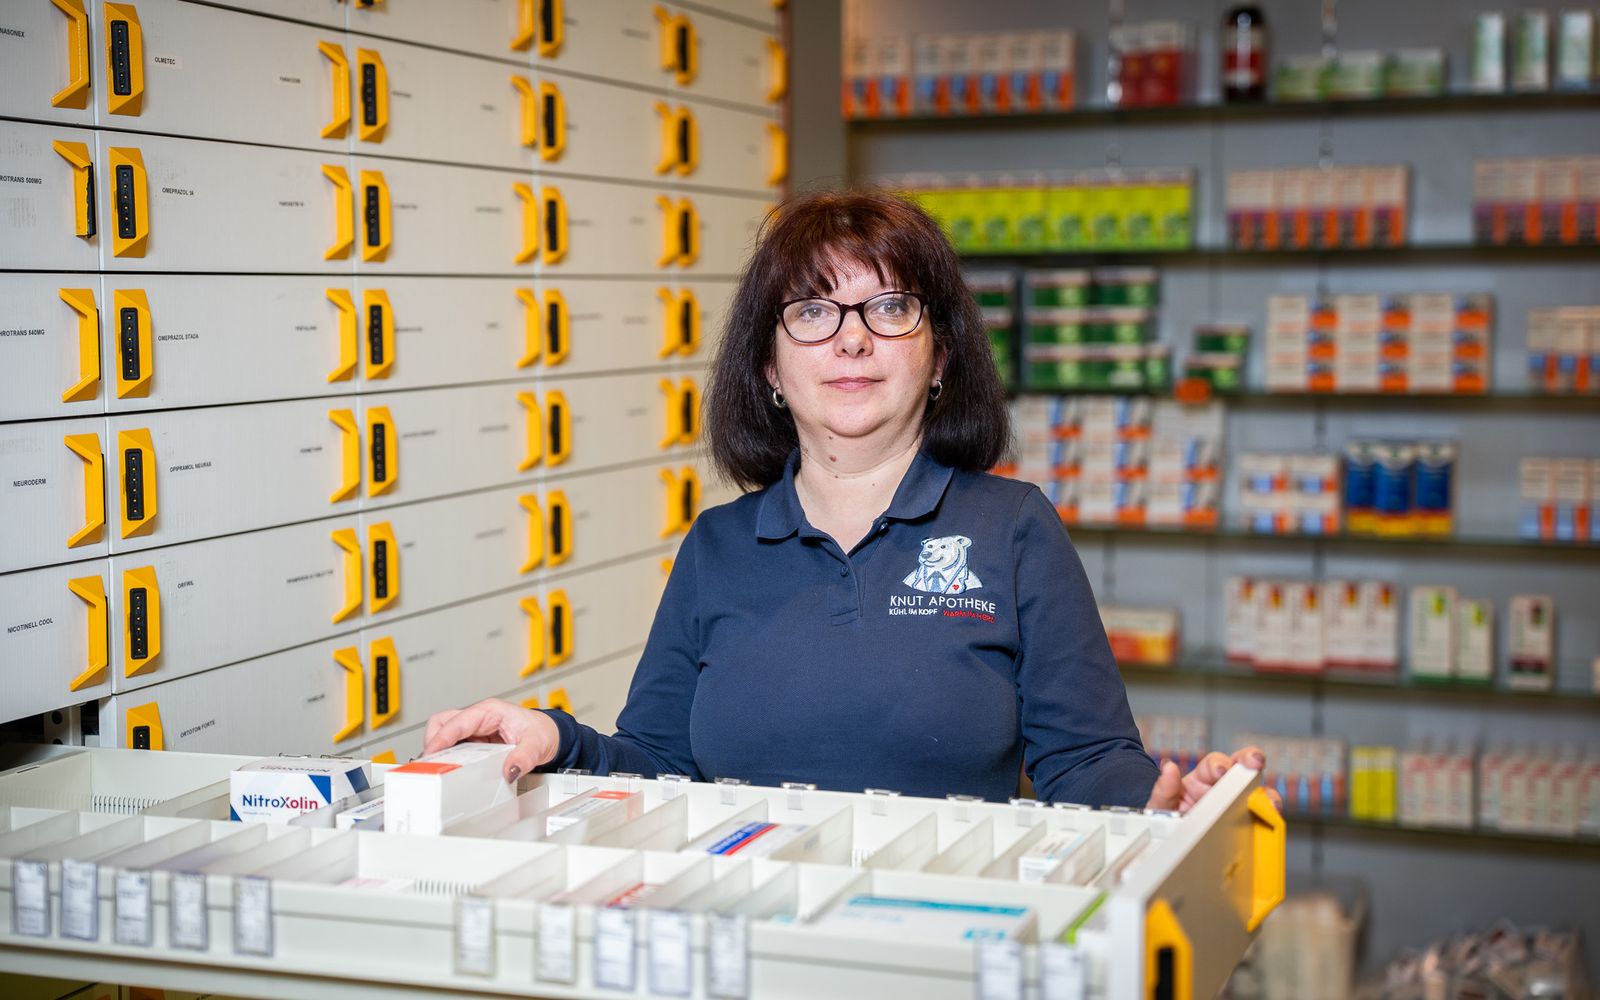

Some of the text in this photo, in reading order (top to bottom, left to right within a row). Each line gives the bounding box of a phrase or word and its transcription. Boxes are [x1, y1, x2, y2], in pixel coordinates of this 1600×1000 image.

[154, 57, 176, 65] OLMETEC
[25, 176, 42, 185] 500MG
[162, 187, 189, 195] OMEPRAZOL
[28, 328, 45, 336] 840MG
[13, 478, 47, 487] NEURODERM
[890, 595, 996, 614] KNUT APOTHEKE
[889, 607, 908, 615] KÜHL
[908, 607, 917, 616] IM
[918, 608, 938, 616] KOPF
[7, 618, 53, 633] NICOTINELL COOL
[242, 794, 319, 810] NitroXolin
